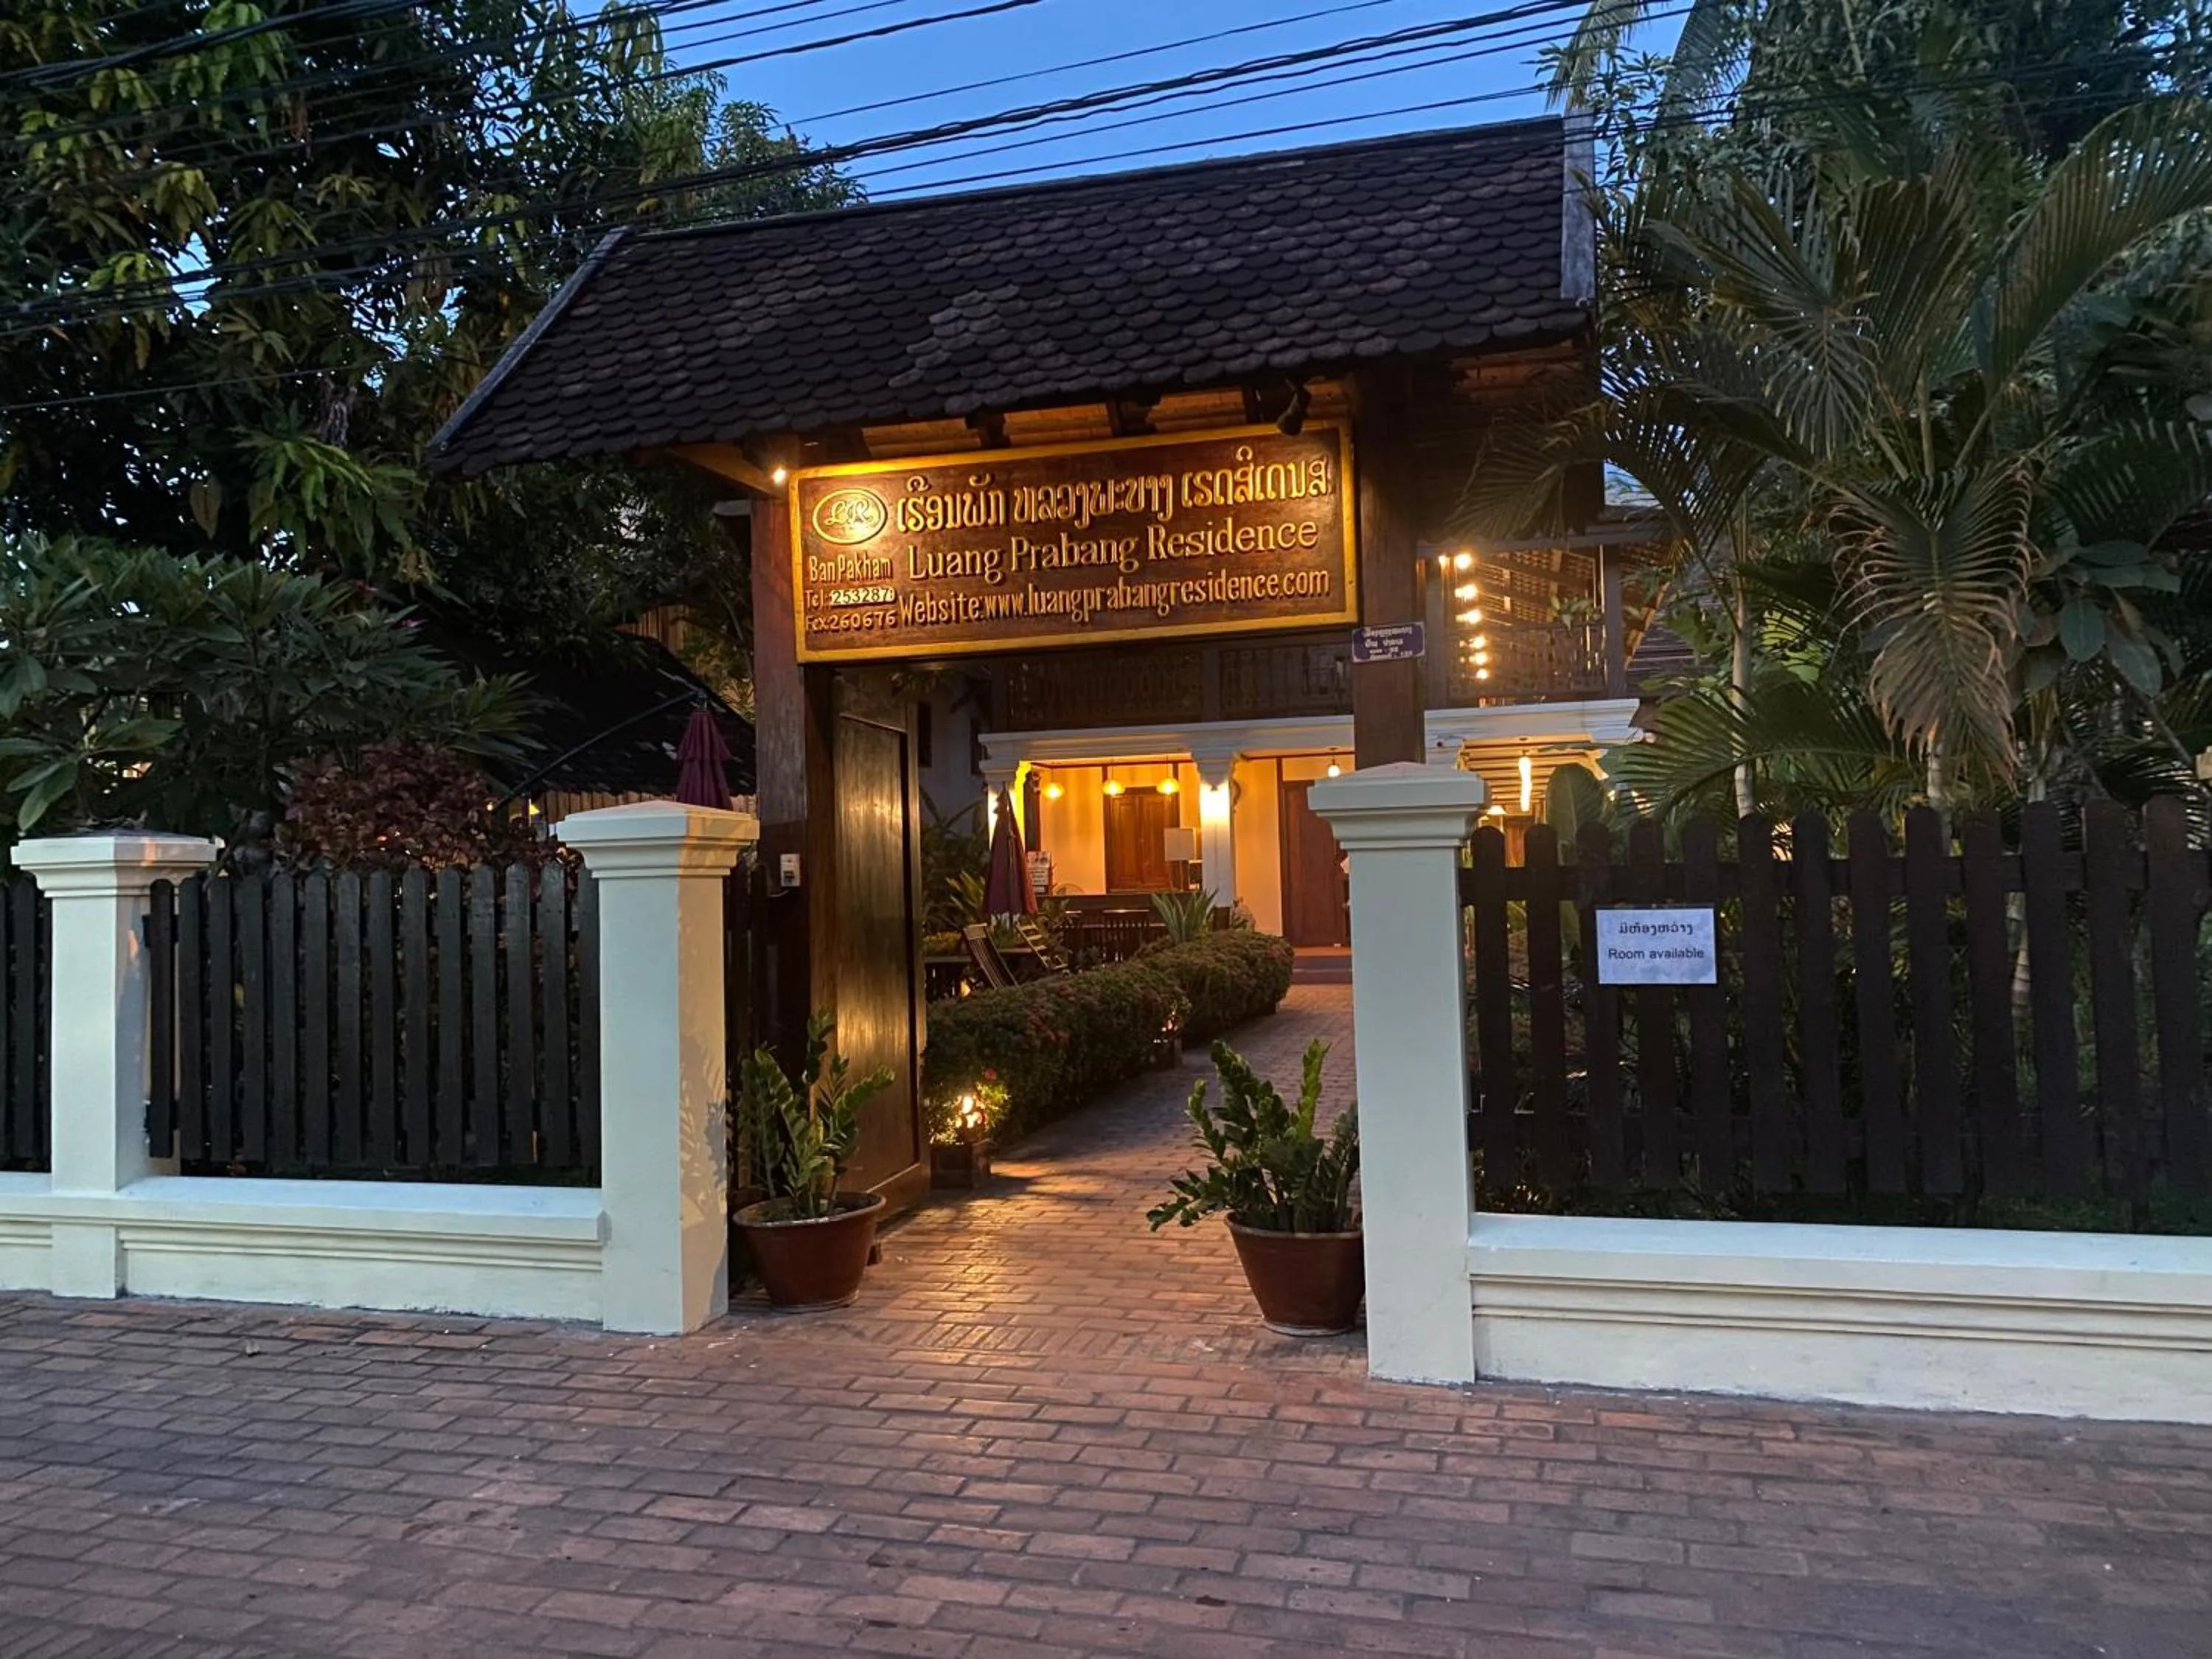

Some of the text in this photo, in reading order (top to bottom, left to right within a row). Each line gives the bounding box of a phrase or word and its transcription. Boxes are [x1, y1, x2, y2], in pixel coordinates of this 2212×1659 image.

[908, 518, 1318, 584] Luang Prabang Residence
[1609, 947, 1705, 959] Room available
